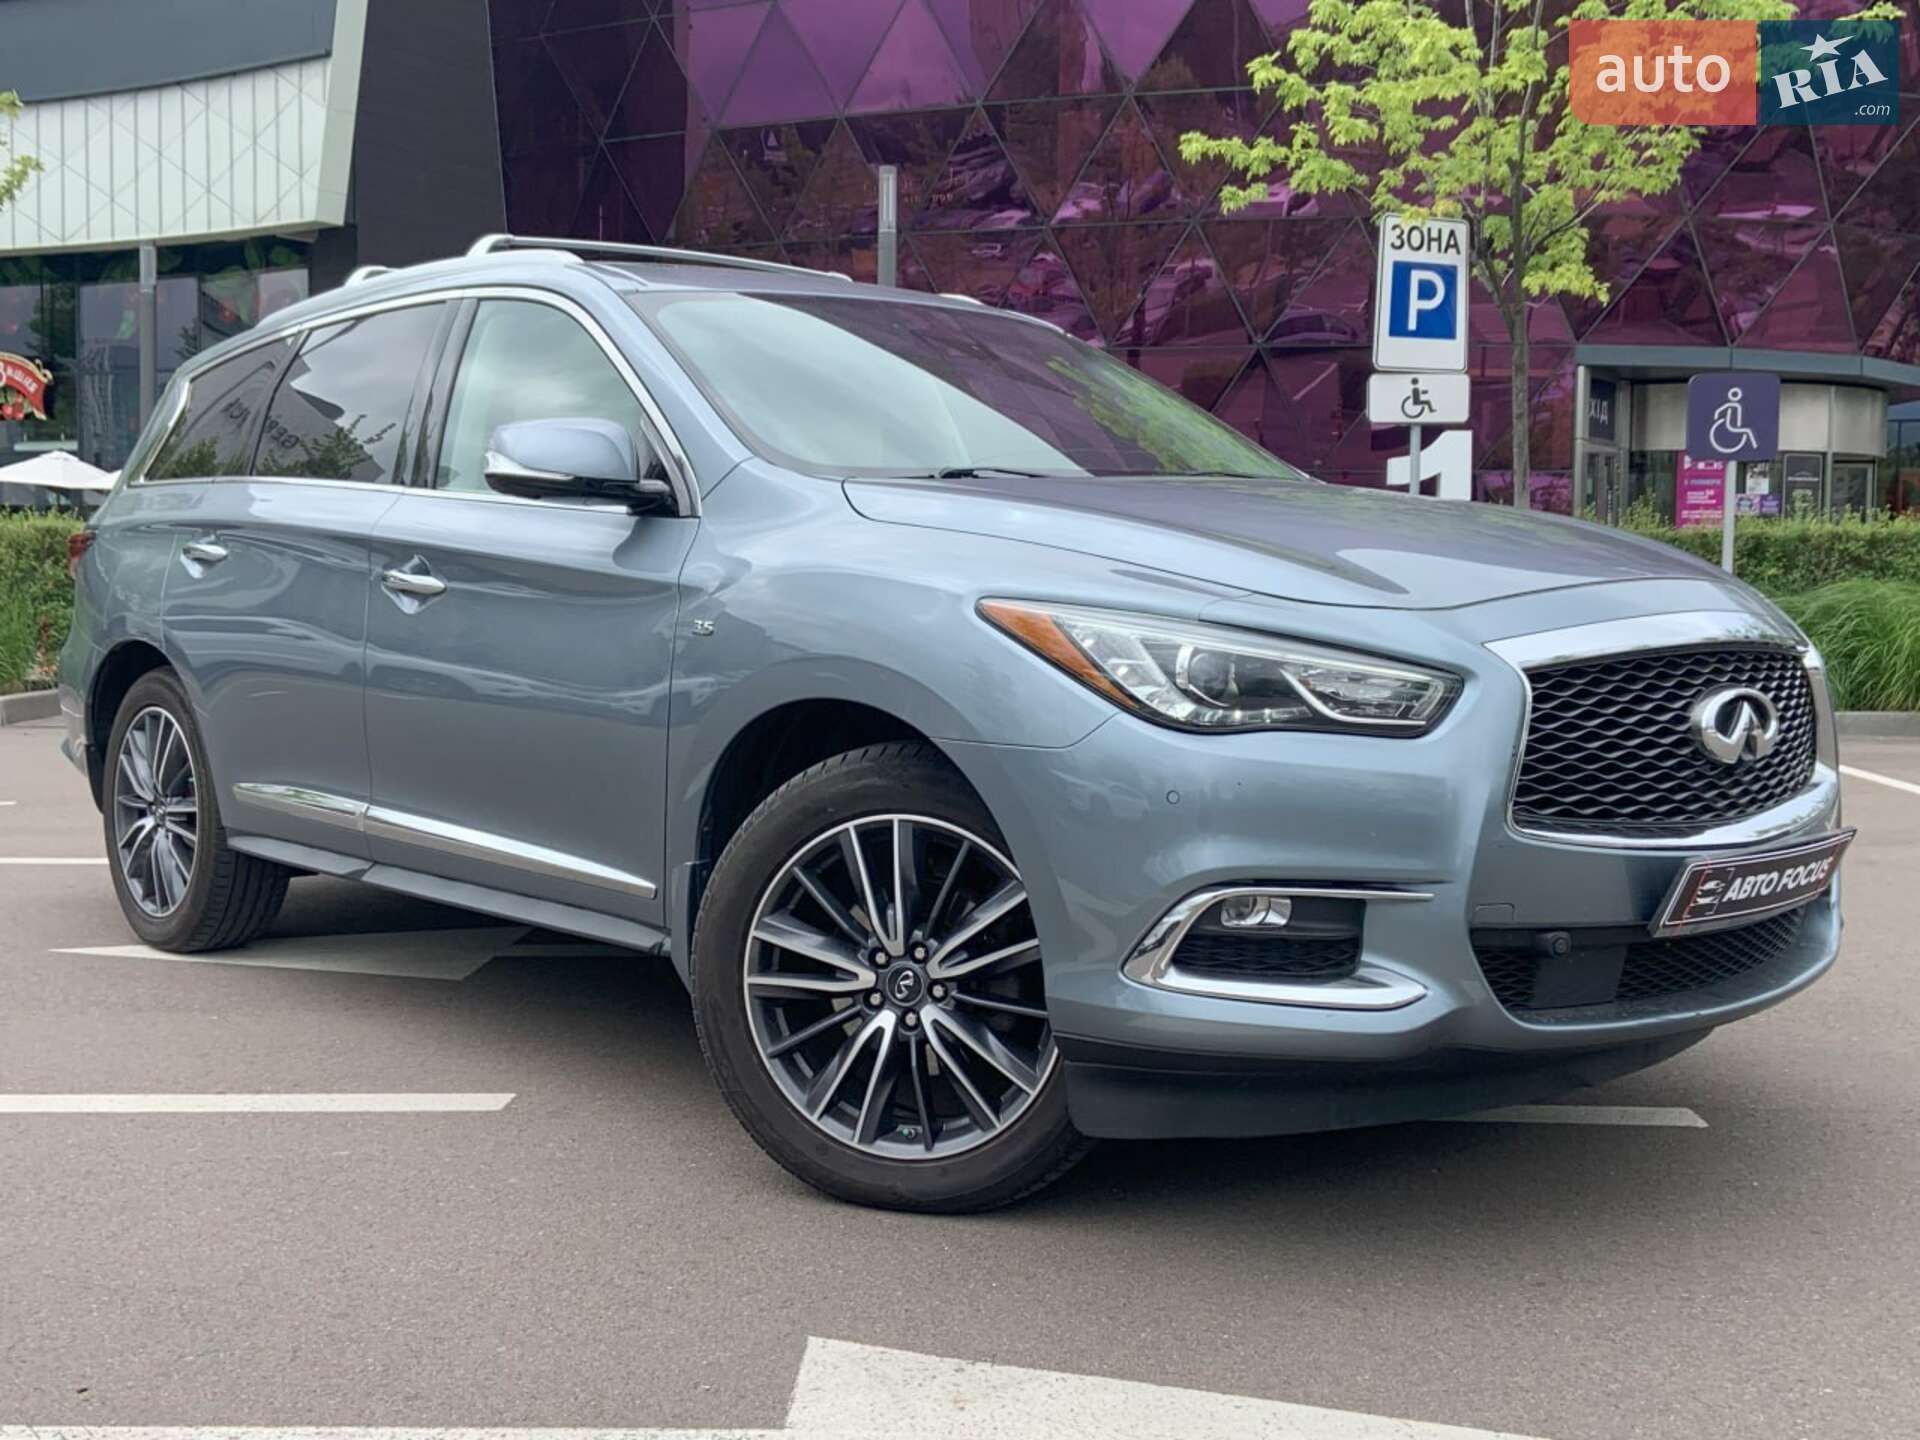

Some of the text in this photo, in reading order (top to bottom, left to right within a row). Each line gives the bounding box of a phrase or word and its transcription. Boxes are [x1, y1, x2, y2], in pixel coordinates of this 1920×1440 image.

[1389, 223, 1462, 256] ЗОНА
[1589, 399, 1609, 425] ХІД
[1386, 430, 1473, 502] 1
[1776, 857, 1833, 891] FOCUS
